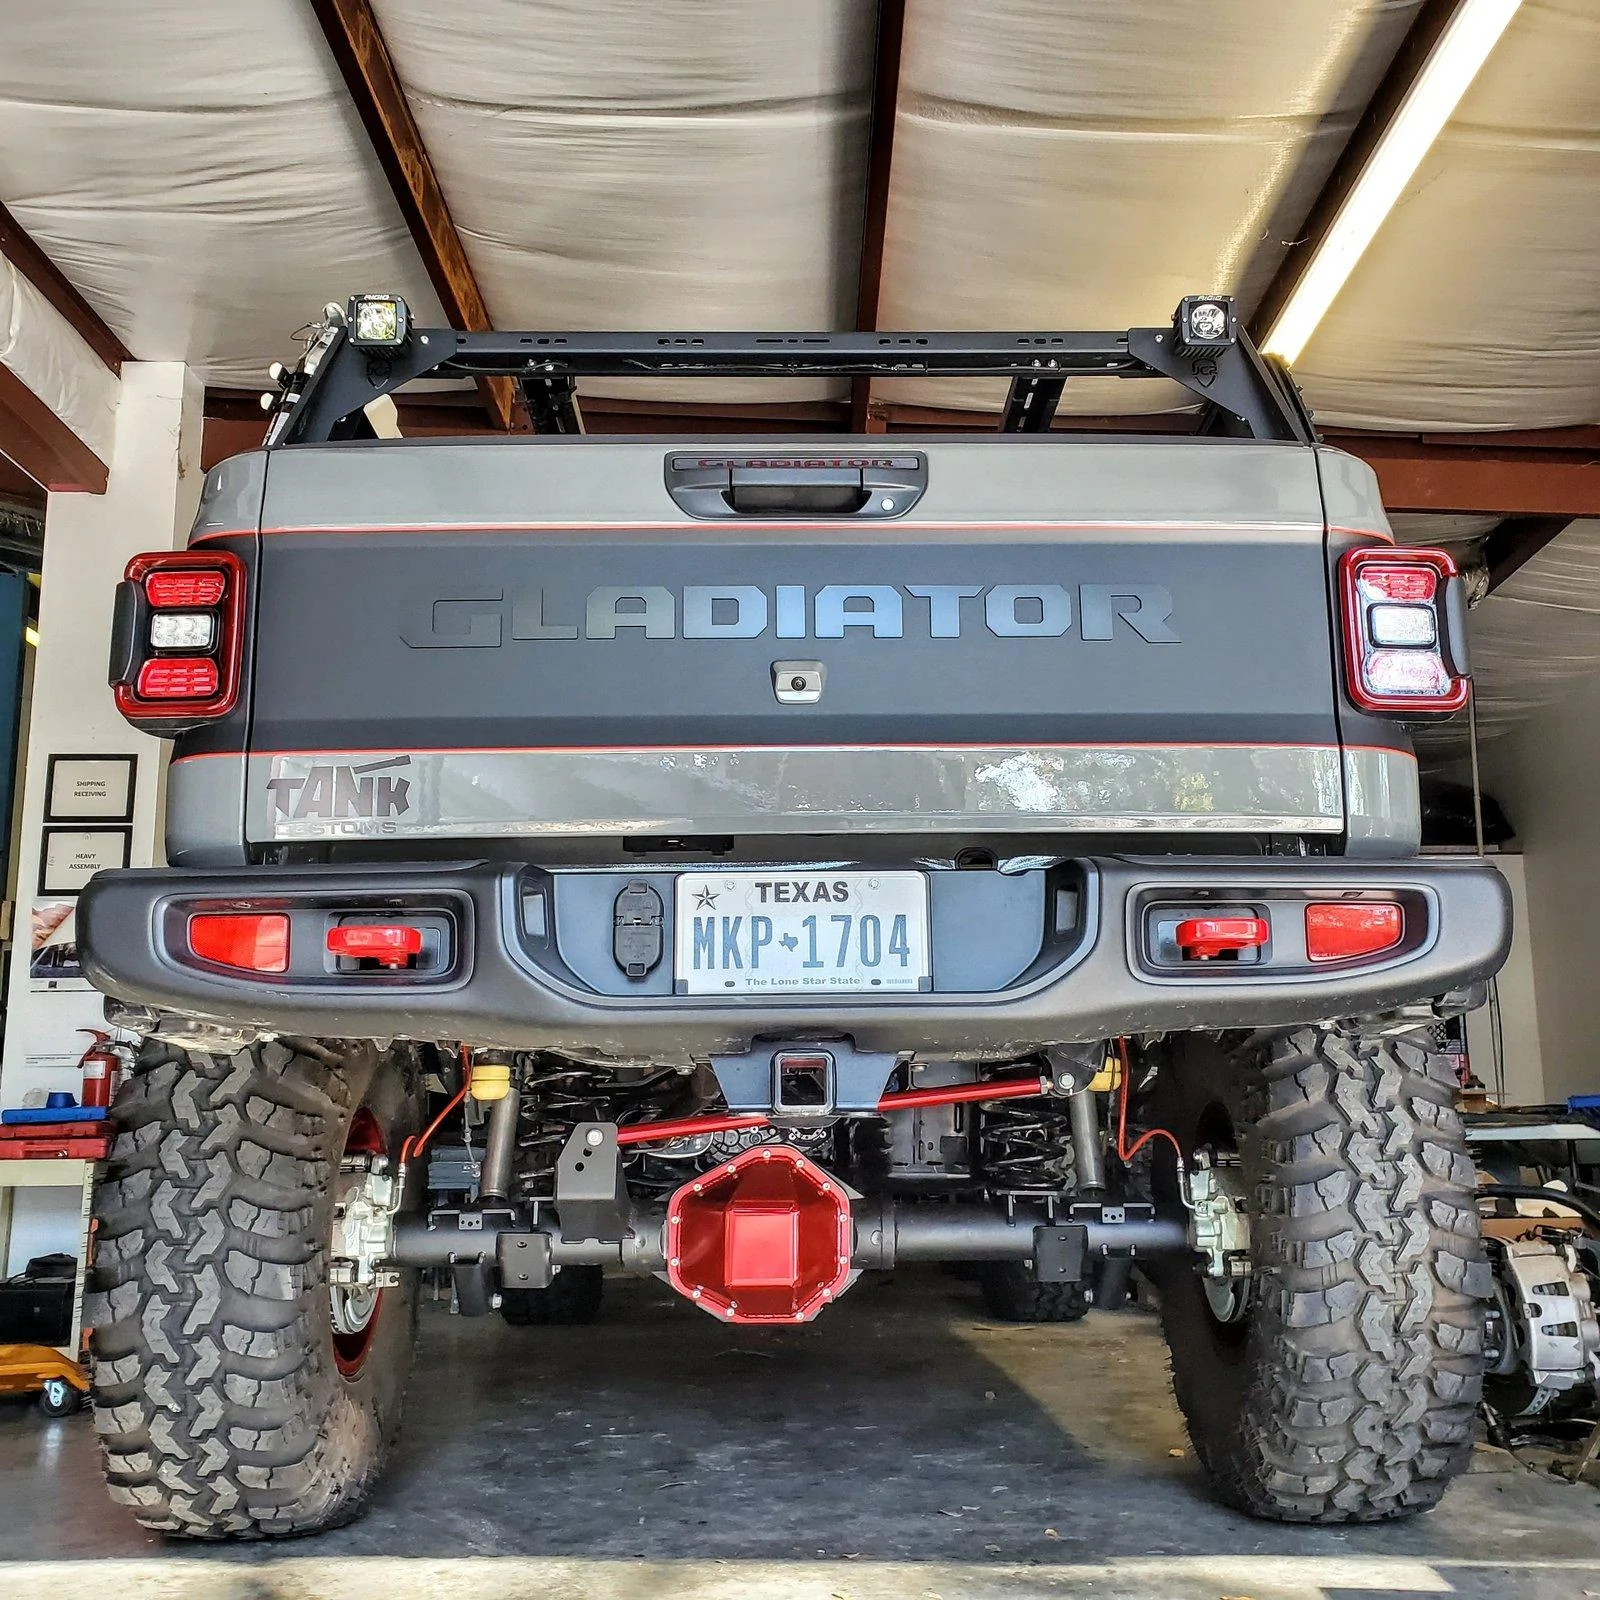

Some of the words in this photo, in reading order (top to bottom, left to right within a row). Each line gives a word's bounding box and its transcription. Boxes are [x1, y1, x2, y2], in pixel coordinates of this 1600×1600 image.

[698, 458, 894, 469] GLADIATOR
[399, 584, 1182, 644] GLADIATOR
[266, 764, 411, 818] TANK
[754, 881, 850, 903] TEXAS
[693, 915, 773, 970] MKP
[802, 914, 911, 968] 1704
[745, 978, 768, 986] The
[770, 978, 799, 986] Lone
[802, 977, 828, 986] Star
[830, 976, 861, 985] State
